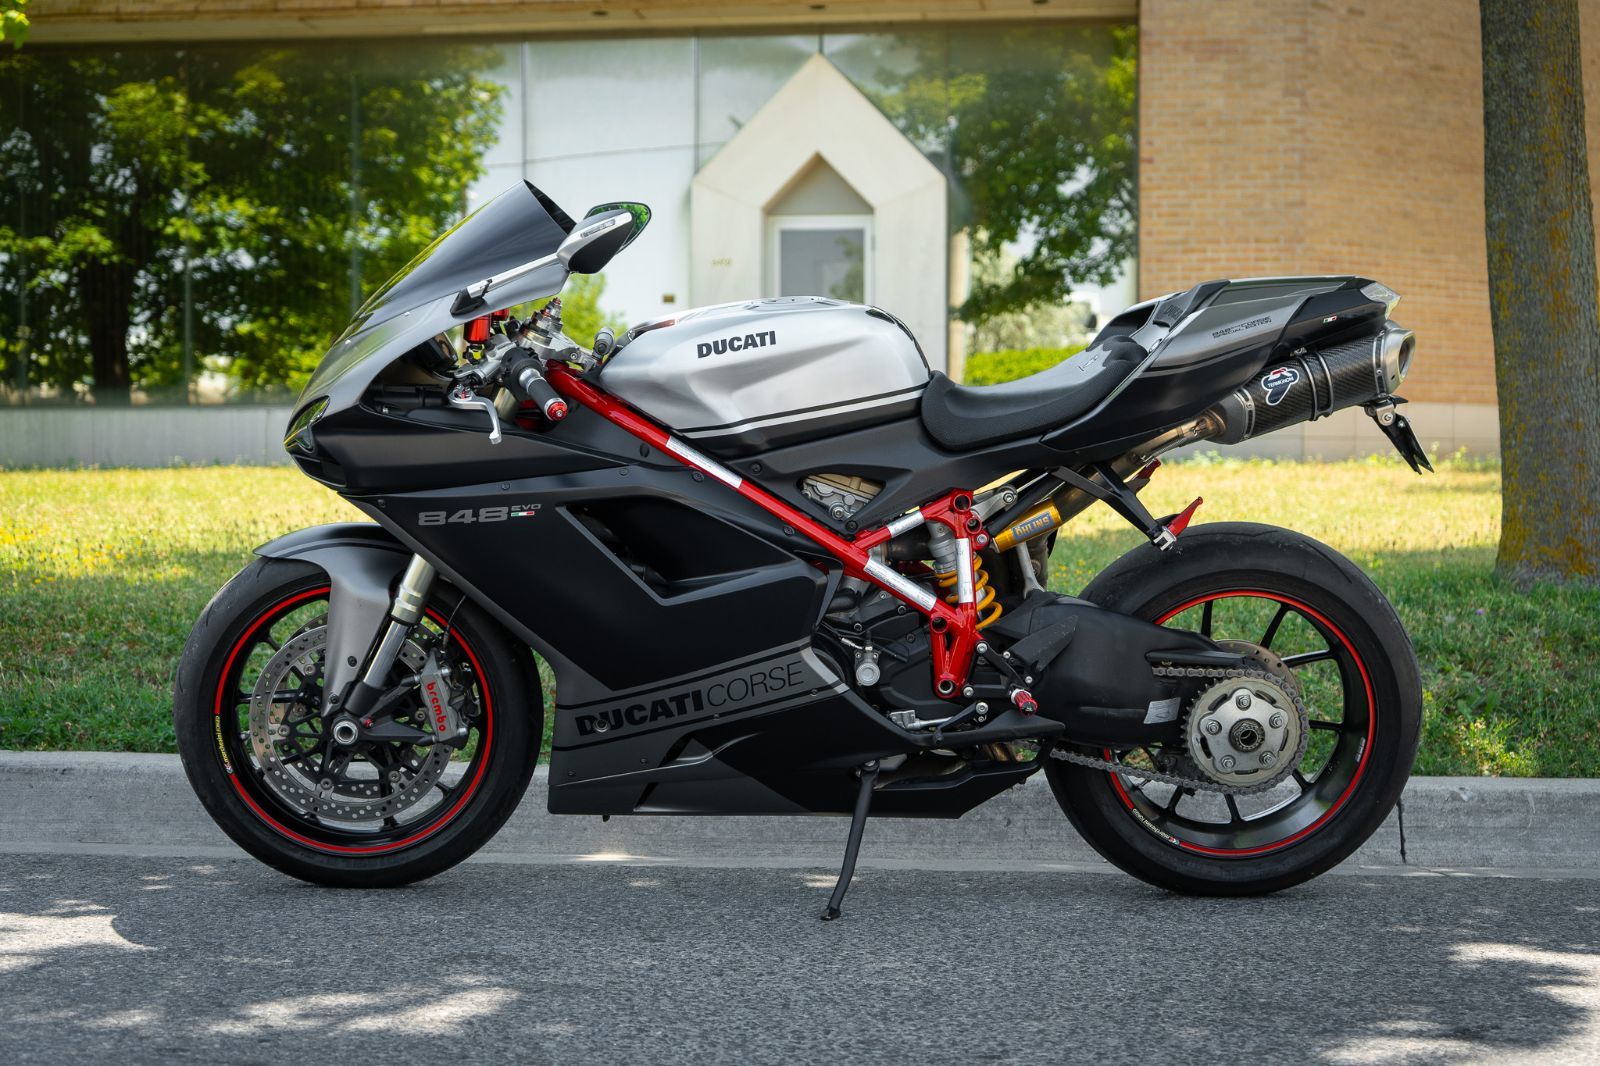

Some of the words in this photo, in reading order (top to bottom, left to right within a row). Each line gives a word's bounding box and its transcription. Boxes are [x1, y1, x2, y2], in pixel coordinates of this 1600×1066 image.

[696, 330, 777, 359] DUCATI
[418, 506, 509, 526] 848
[511, 503, 542, 511] EVO
[426, 681, 447, 732] brembo
[575, 688, 705, 737] DUCATI
[706, 660, 805, 707] CORSE
